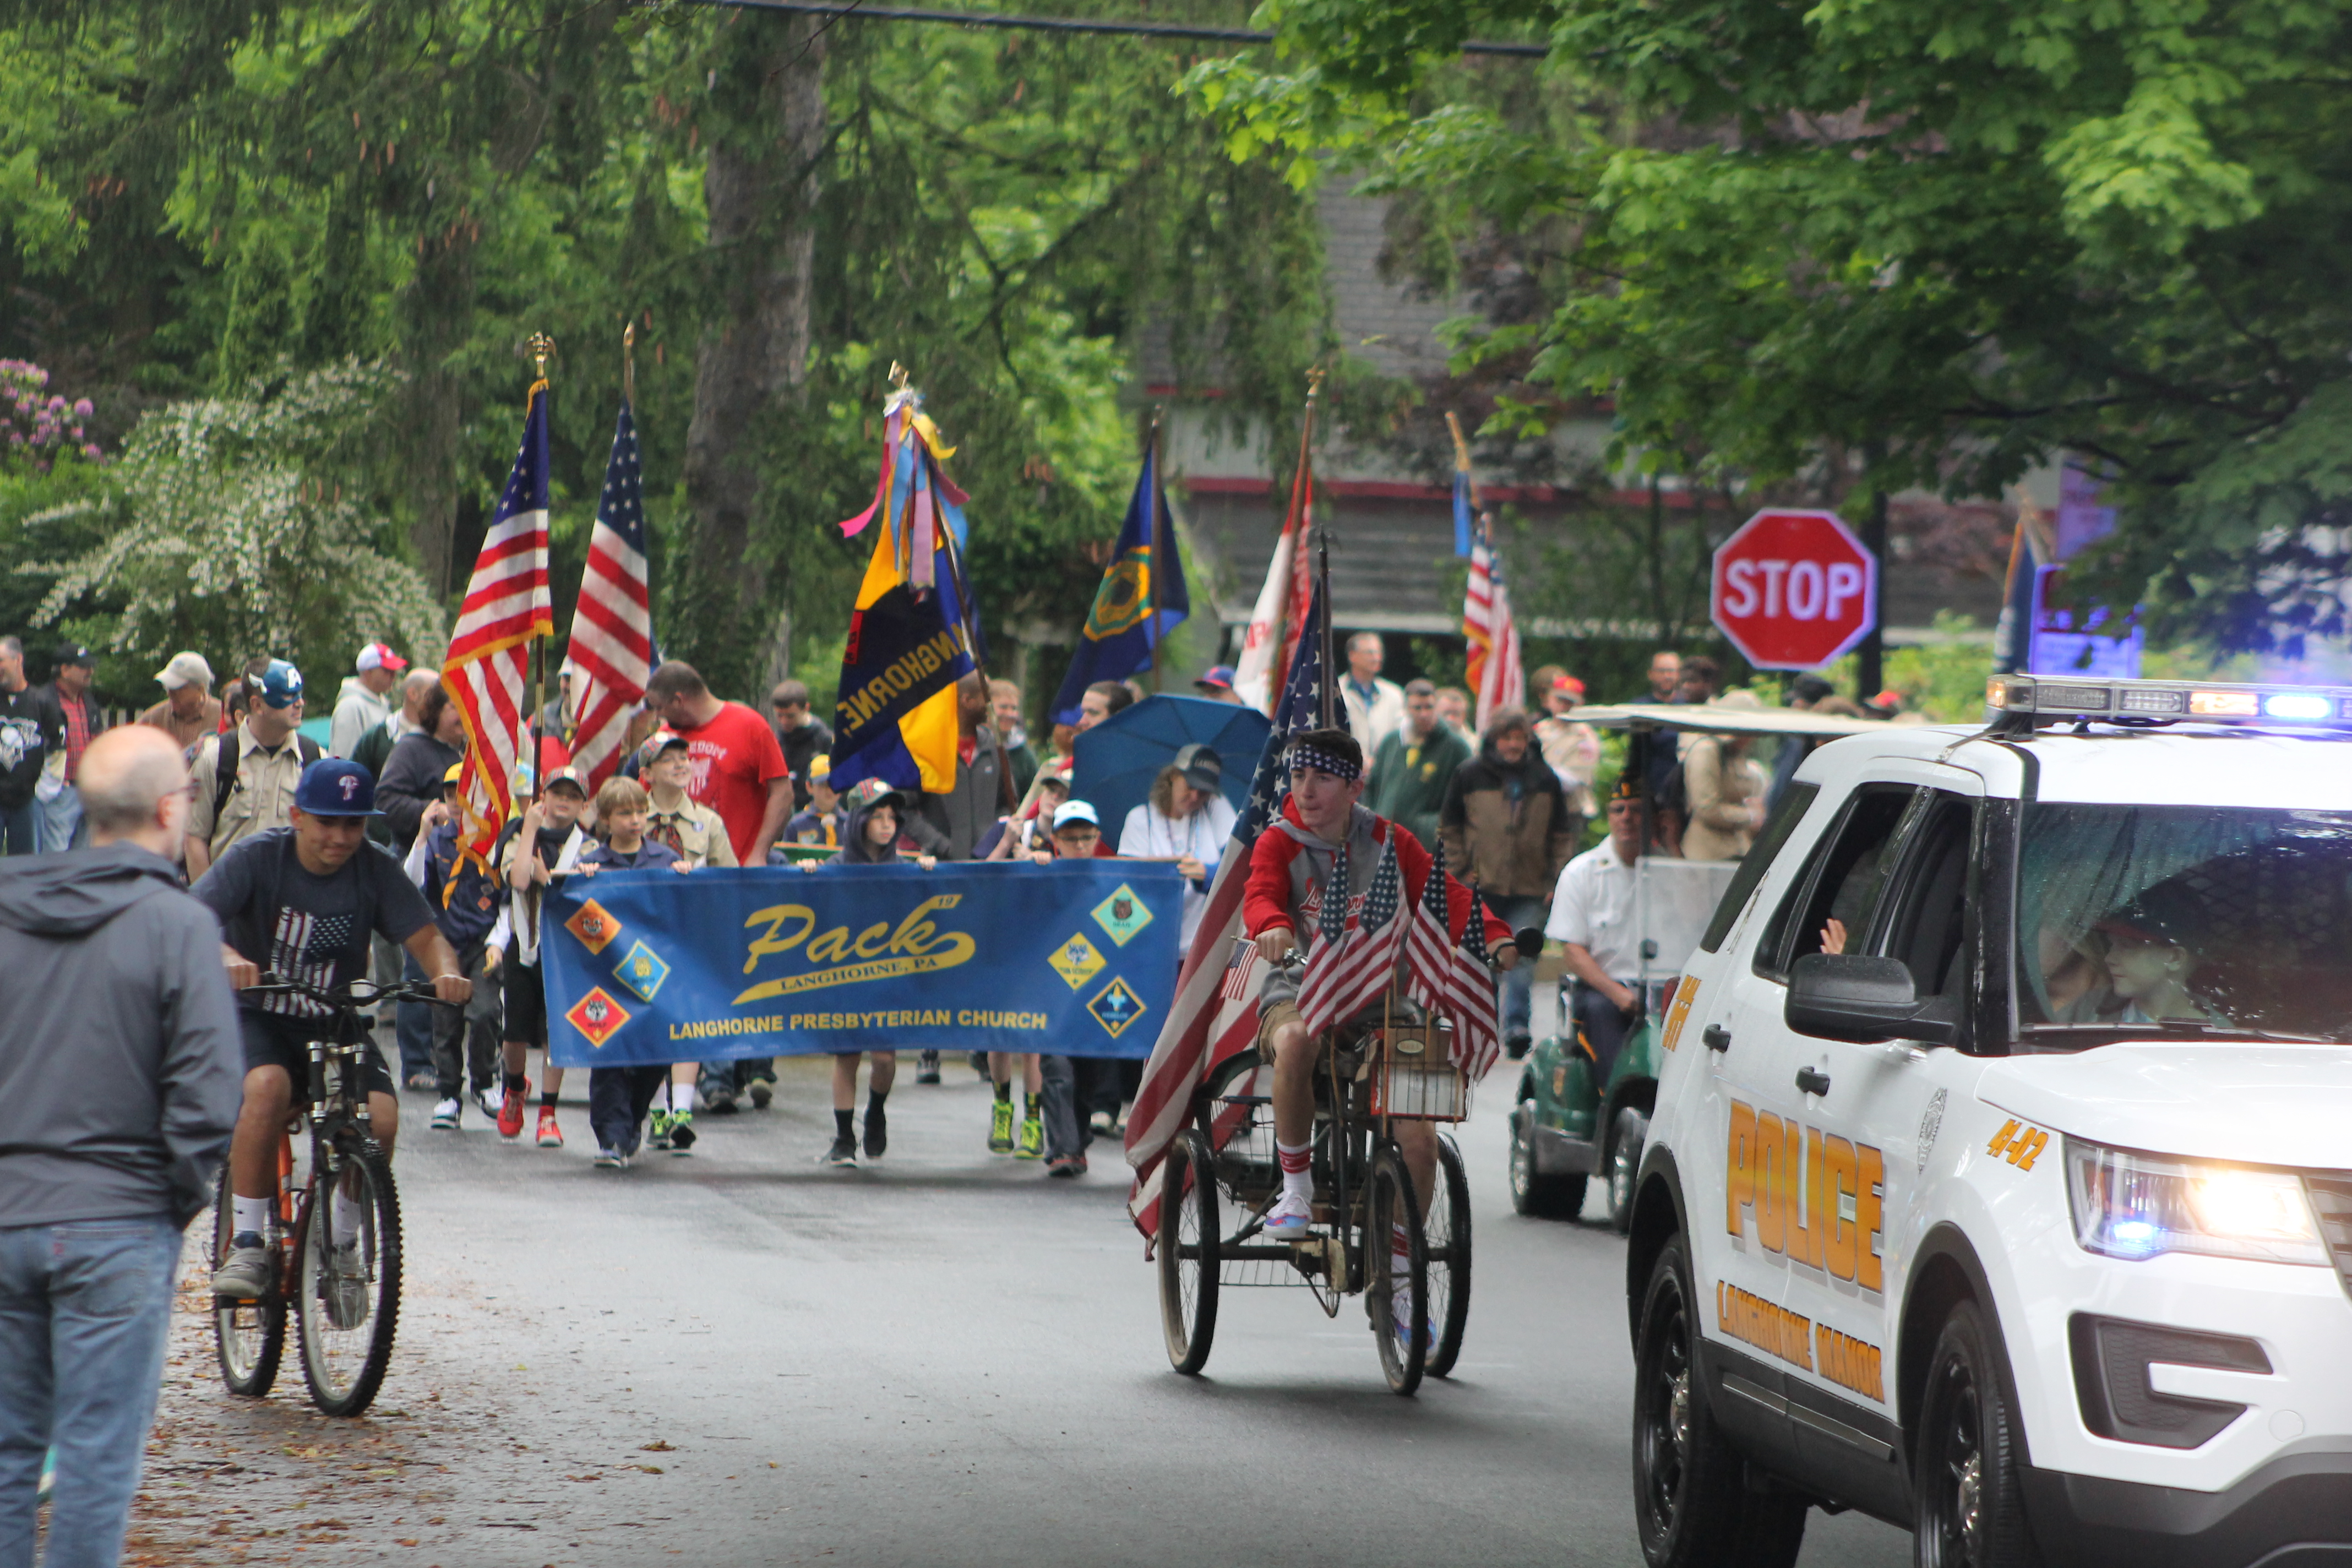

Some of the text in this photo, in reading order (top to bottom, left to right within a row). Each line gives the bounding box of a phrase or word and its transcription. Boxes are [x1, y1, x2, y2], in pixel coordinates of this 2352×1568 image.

[1724, 558, 1864, 621] STOP
[287, 667, 302, 689] A
[743, 894, 962, 974] Pack
[914, 957, 938, 970] PA
[669, 1009, 1047, 1041] LANGHORNE PRESBYTERIAN CHURCH
[1727, 1097, 1883, 1294] POLICE
[1717, 1279, 1886, 1405] LANGHORNE MANOR
